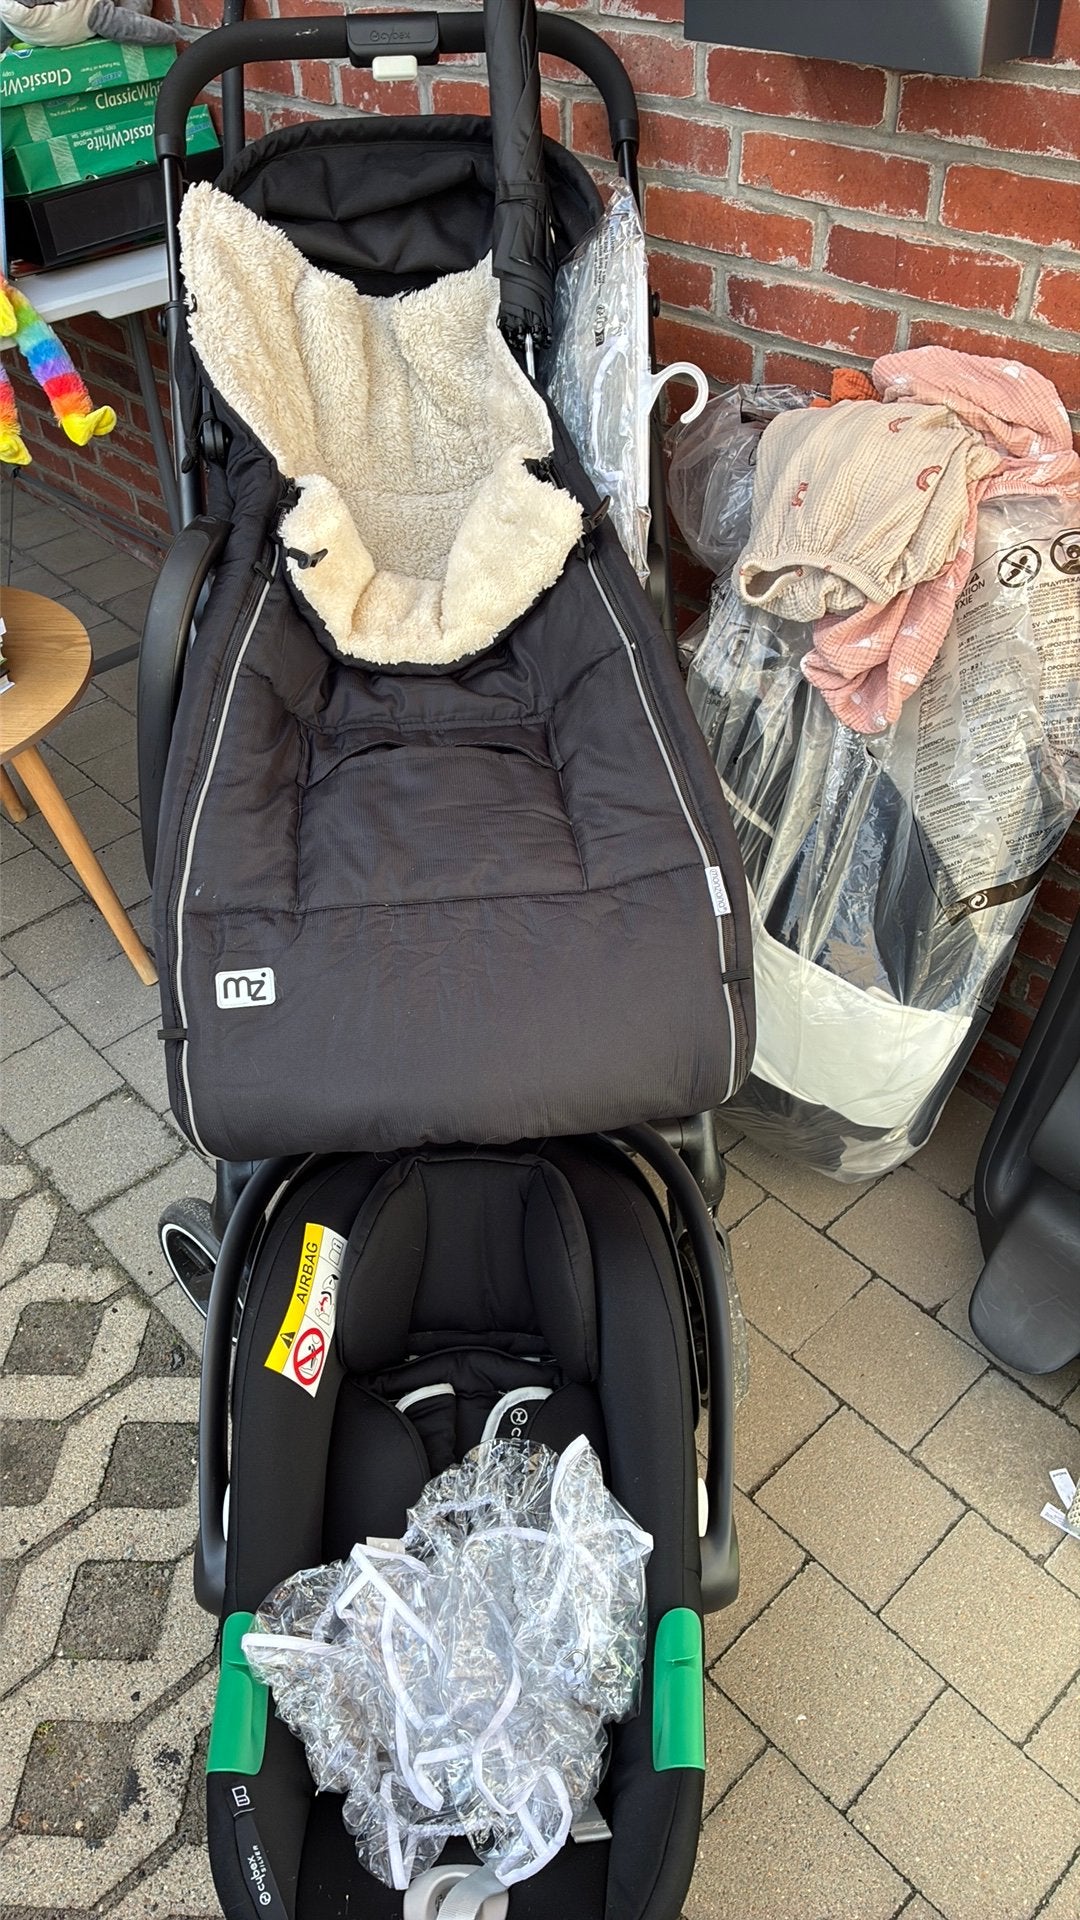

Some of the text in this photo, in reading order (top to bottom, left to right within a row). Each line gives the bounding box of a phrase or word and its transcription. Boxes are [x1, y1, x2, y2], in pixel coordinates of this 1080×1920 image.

[380, 26, 410, 42] cybex
[87, 123, 155, 152] assicWhite
[297, 1242, 318, 1305] AIRBAG
[248, 1855, 265, 1891] cybex
[253, 1845, 266, 1873] SILVER
